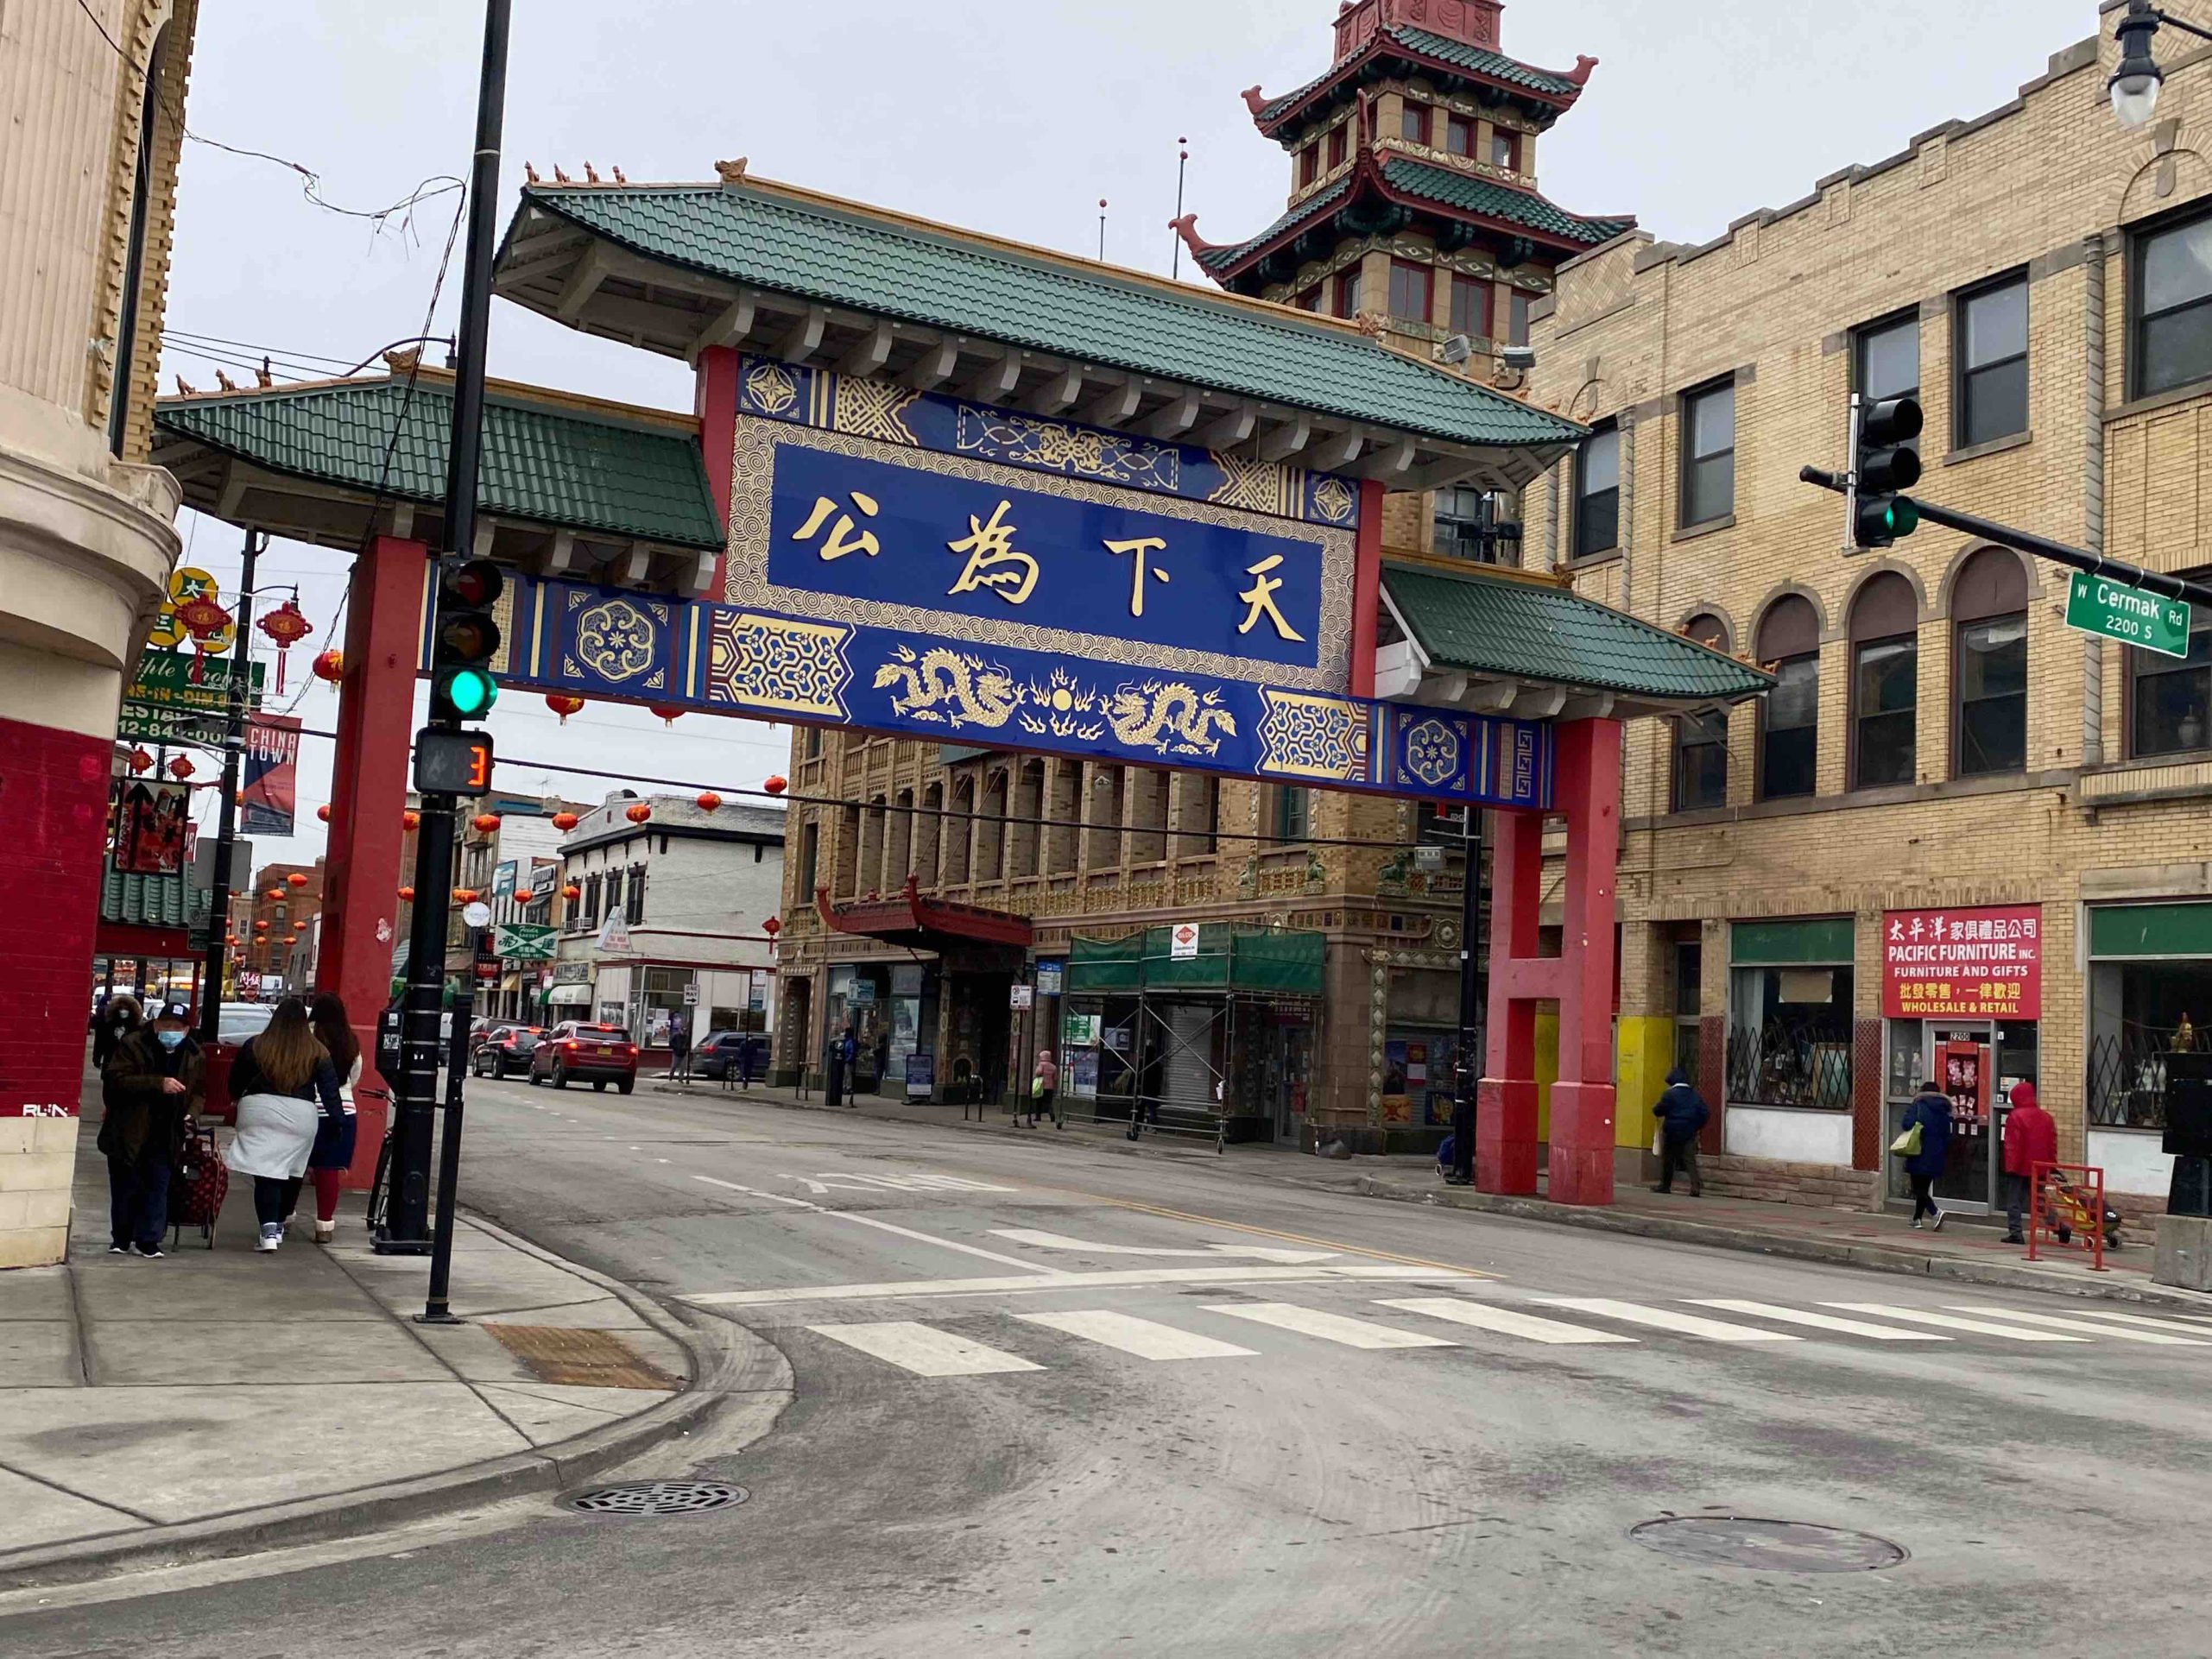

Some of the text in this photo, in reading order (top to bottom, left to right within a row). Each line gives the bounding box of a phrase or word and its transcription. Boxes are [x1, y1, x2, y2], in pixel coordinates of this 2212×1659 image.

[2077, 583, 2183, 626] W Cermak Rd
[2106, 615, 2152, 640] 2200 S
[250, 728, 296, 749] CHINA
[250, 744, 294, 766] TOWN
[467, 747, 485, 785] 3
[1889, 943, 2036, 962] PACIFIC FURNITURE INC.
[1894, 966, 2028, 977] FURNITURE AND GIFTS
[1902, 1002, 2019, 1013] WHOLESALE & RETAIL
[1950, 1032, 1970, 1041] 2200
